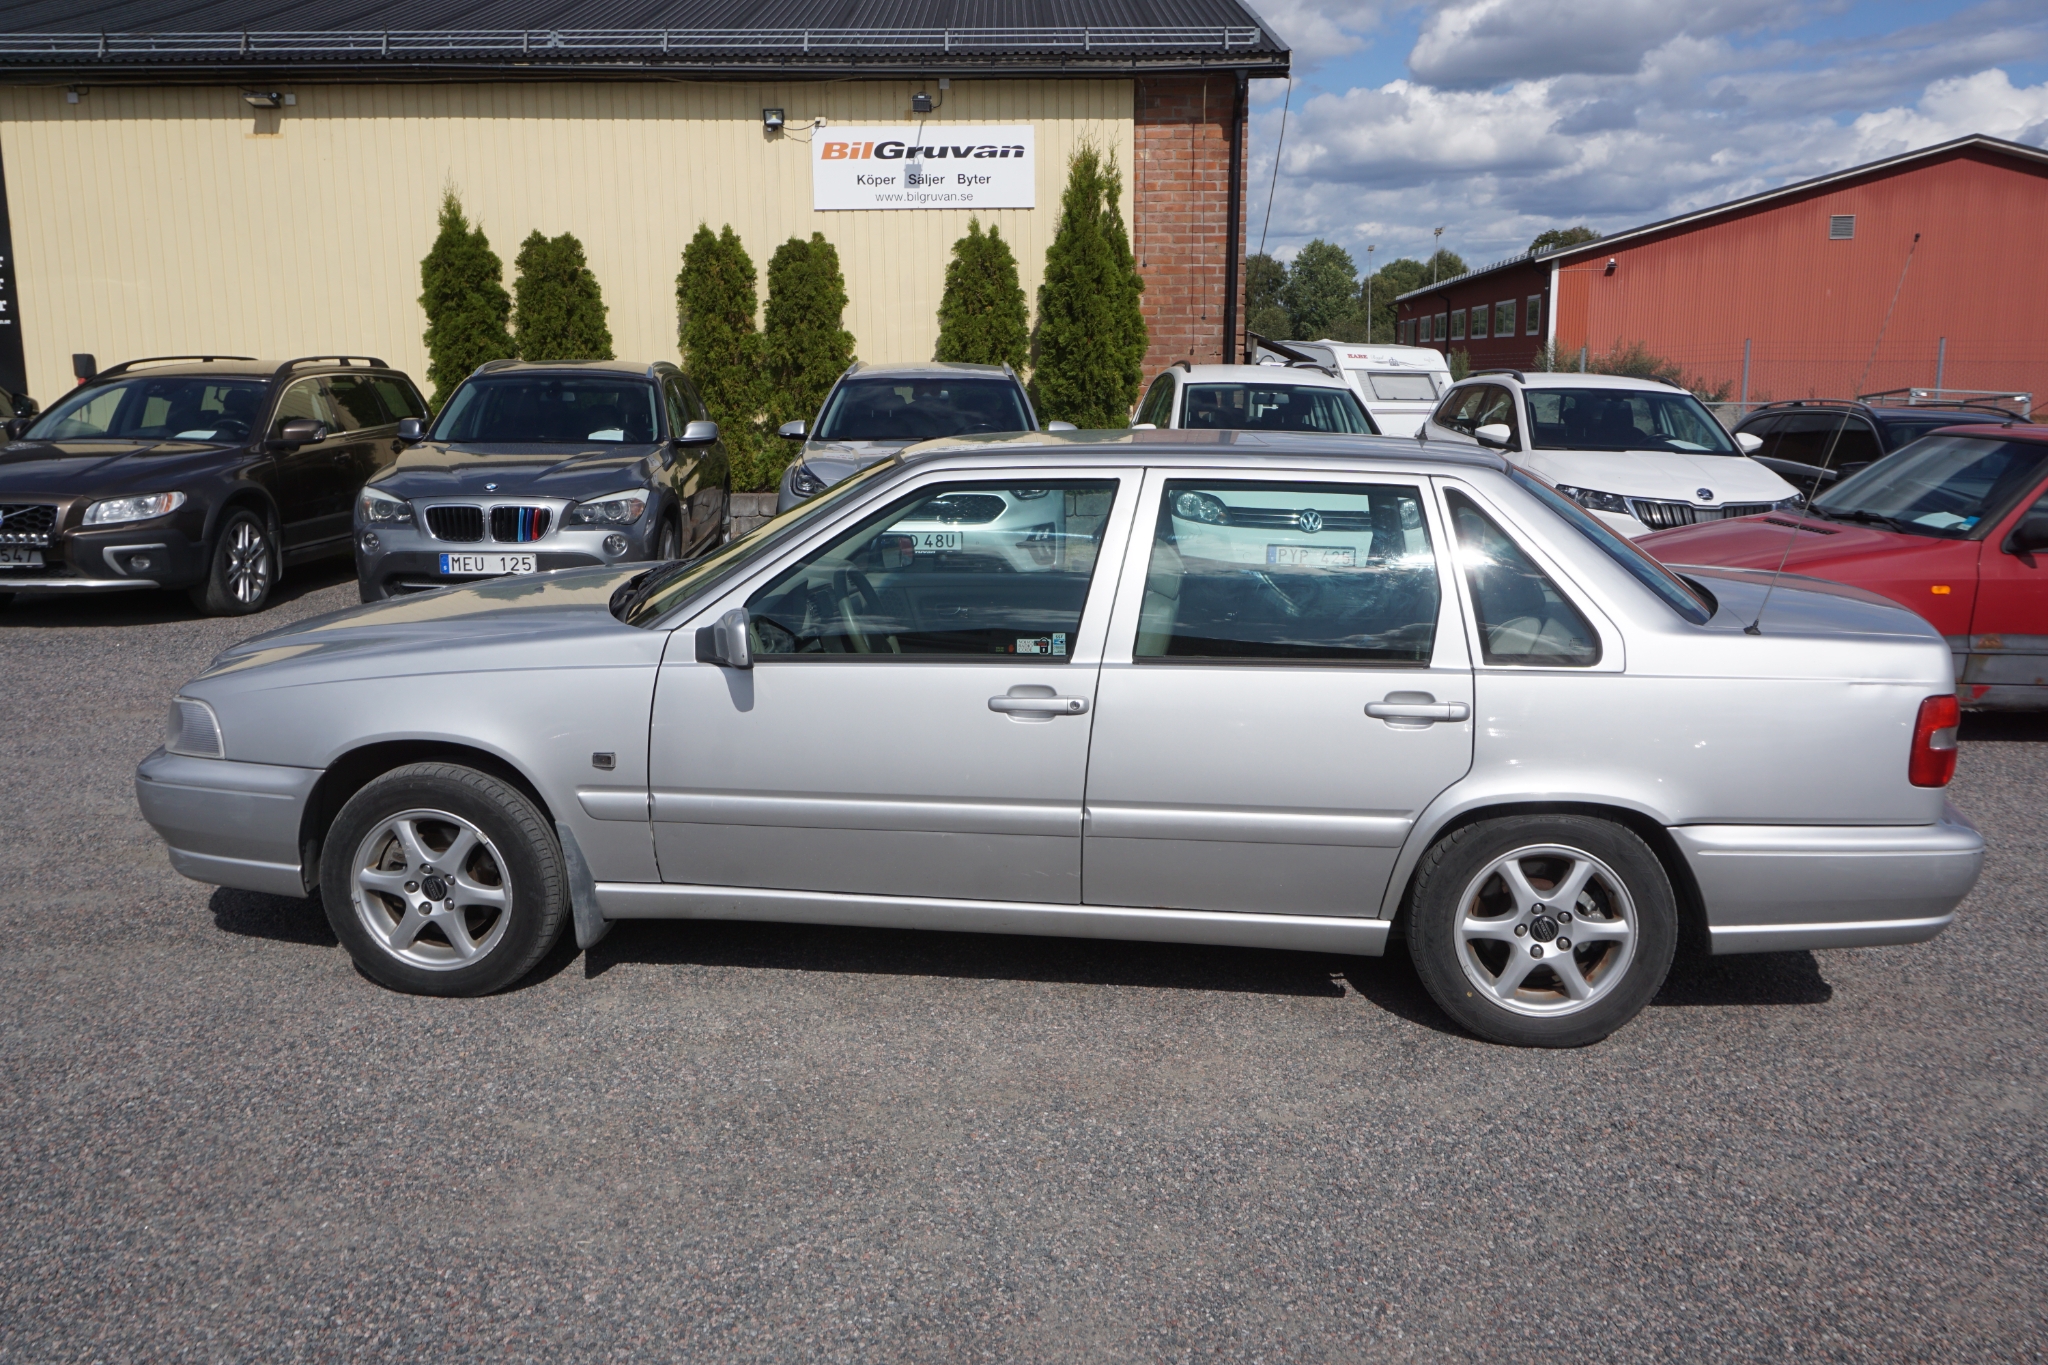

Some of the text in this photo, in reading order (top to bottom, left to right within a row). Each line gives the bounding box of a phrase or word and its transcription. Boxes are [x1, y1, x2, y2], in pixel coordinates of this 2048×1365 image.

[821, 141, 1025, 160] BilGruvan
[857, 173, 991, 187] Köper Säljer Byter
[875, 192, 974, 204] www.bilgruvan.se
[924, 534, 955, 548] 48U
[1278, 548, 1350, 565] PYP 425
[451, 557, 532, 571] MEU 125
